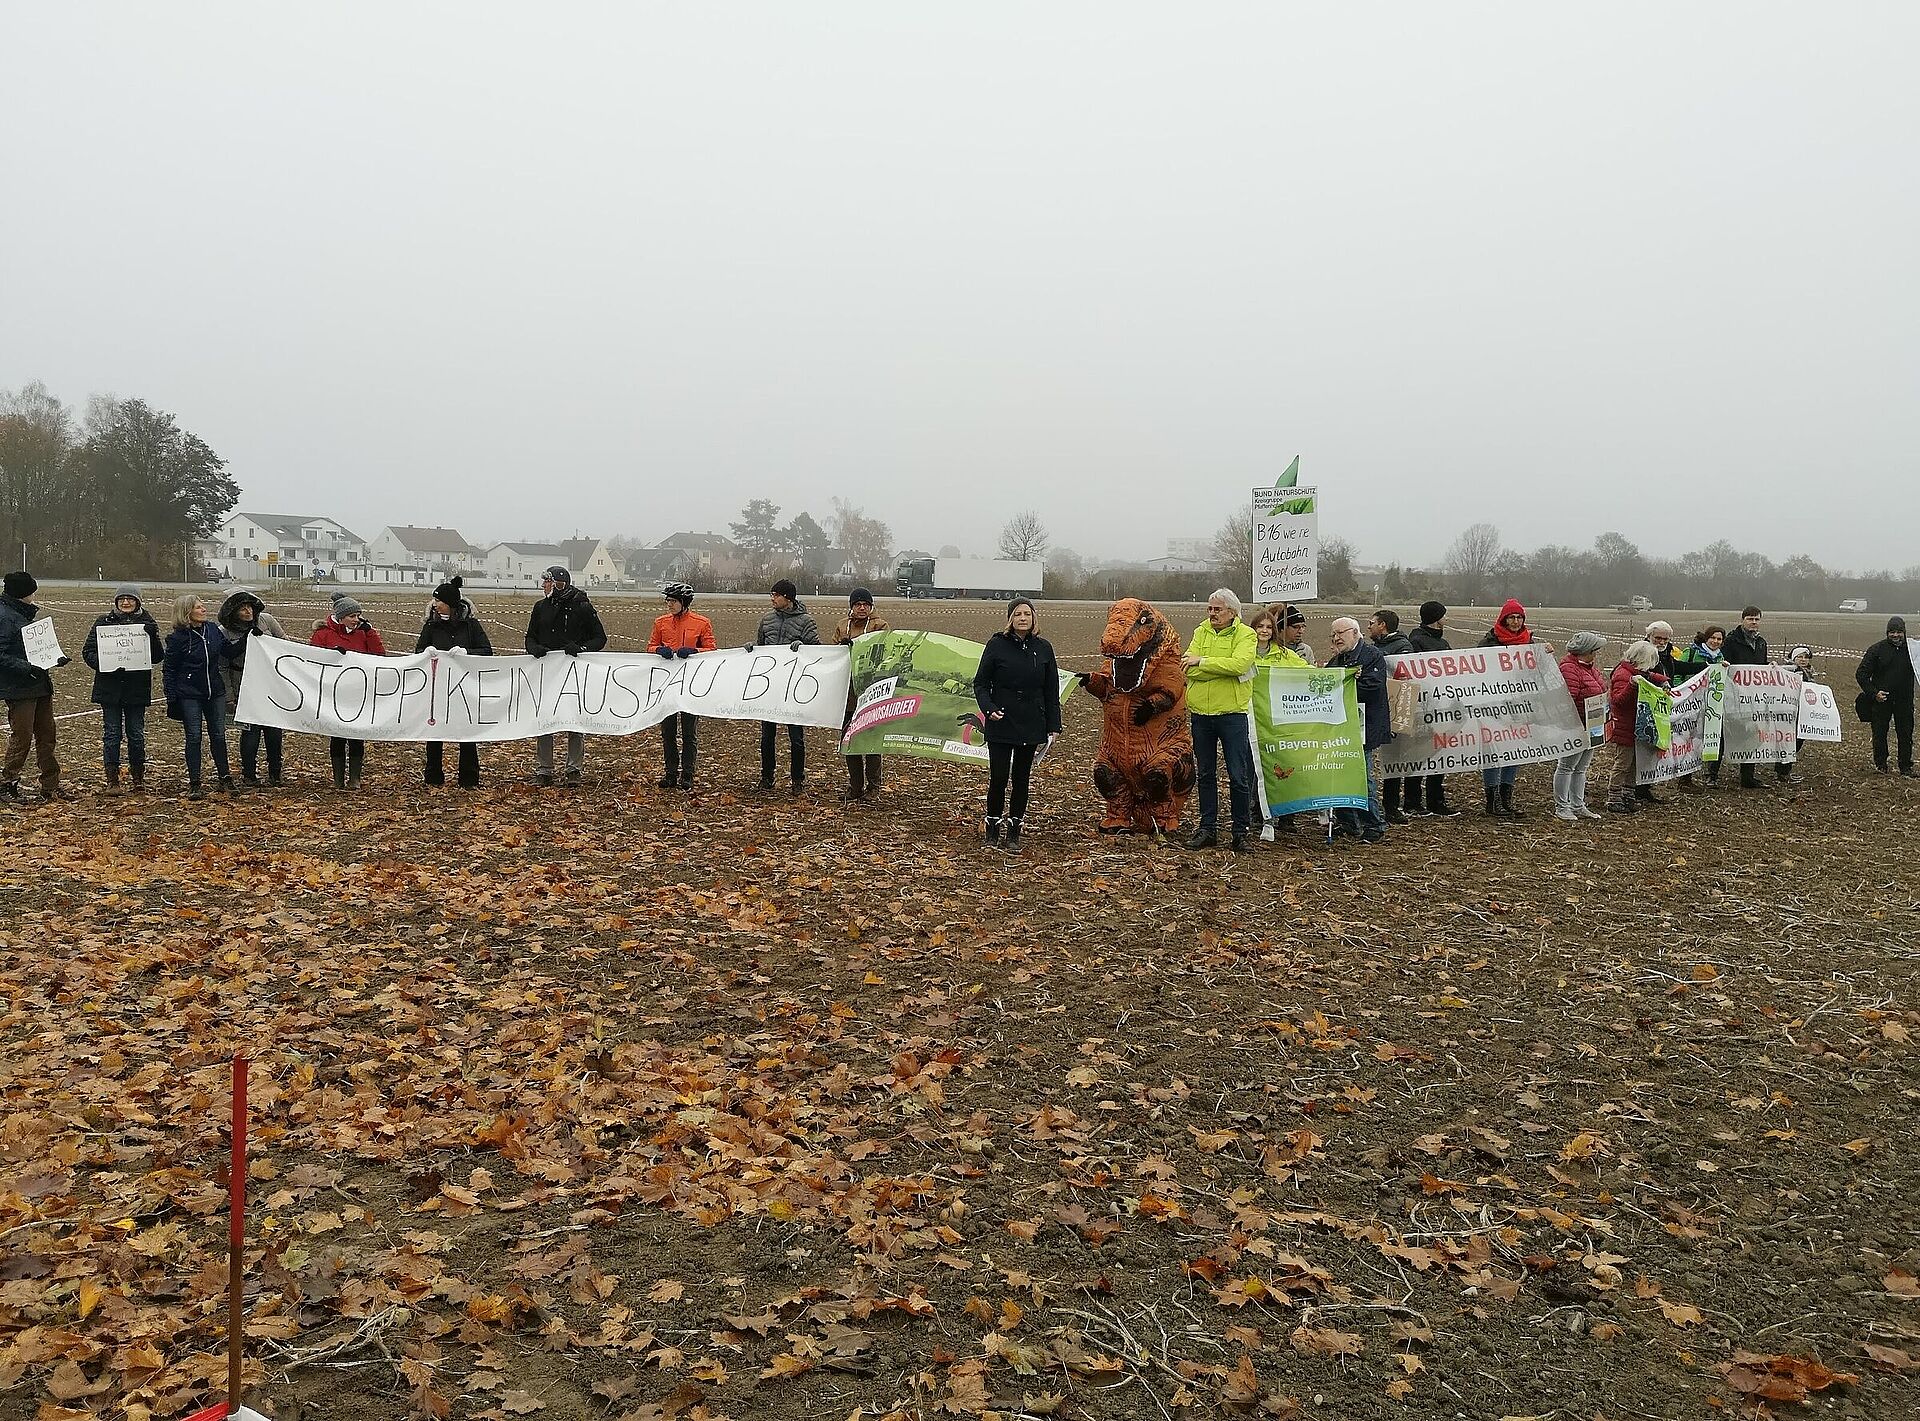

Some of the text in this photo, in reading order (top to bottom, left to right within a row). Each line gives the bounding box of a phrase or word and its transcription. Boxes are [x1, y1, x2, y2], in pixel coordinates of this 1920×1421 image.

[1274, 488, 1316, 496] NATURSCHUTZ
[1257, 523, 1282, 541] B16
[1260, 545, 1309, 564] Autobahn
[1260, 564, 1289, 579] Stoppt
[26, 621, 49, 640] STOP
[115, 638, 134, 647] KEIN
[1392, 650, 1537, 680] AUSBAU B16
[552, 660, 726, 719] AUSBAU
[742, 655, 823, 705] B16
[1732, 669, 1786, 687] AUSBAU
[1281, 694, 1311, 702] BUND
[1433, 679, 1539, 702] 4-Spur-Autobahn
[1424, 699, 1534, 724] ohne Tempolimit
[1279, 740, 1319, 751] Bayern
[1321, 736, 1351, 750] aktiv
[1432, 723, 1533, 750] Nein Danke!
[1384, 738, 1583, 774] www.b16-keine-autobahn.de
[1302, 762, 1345, 772] und Natur
